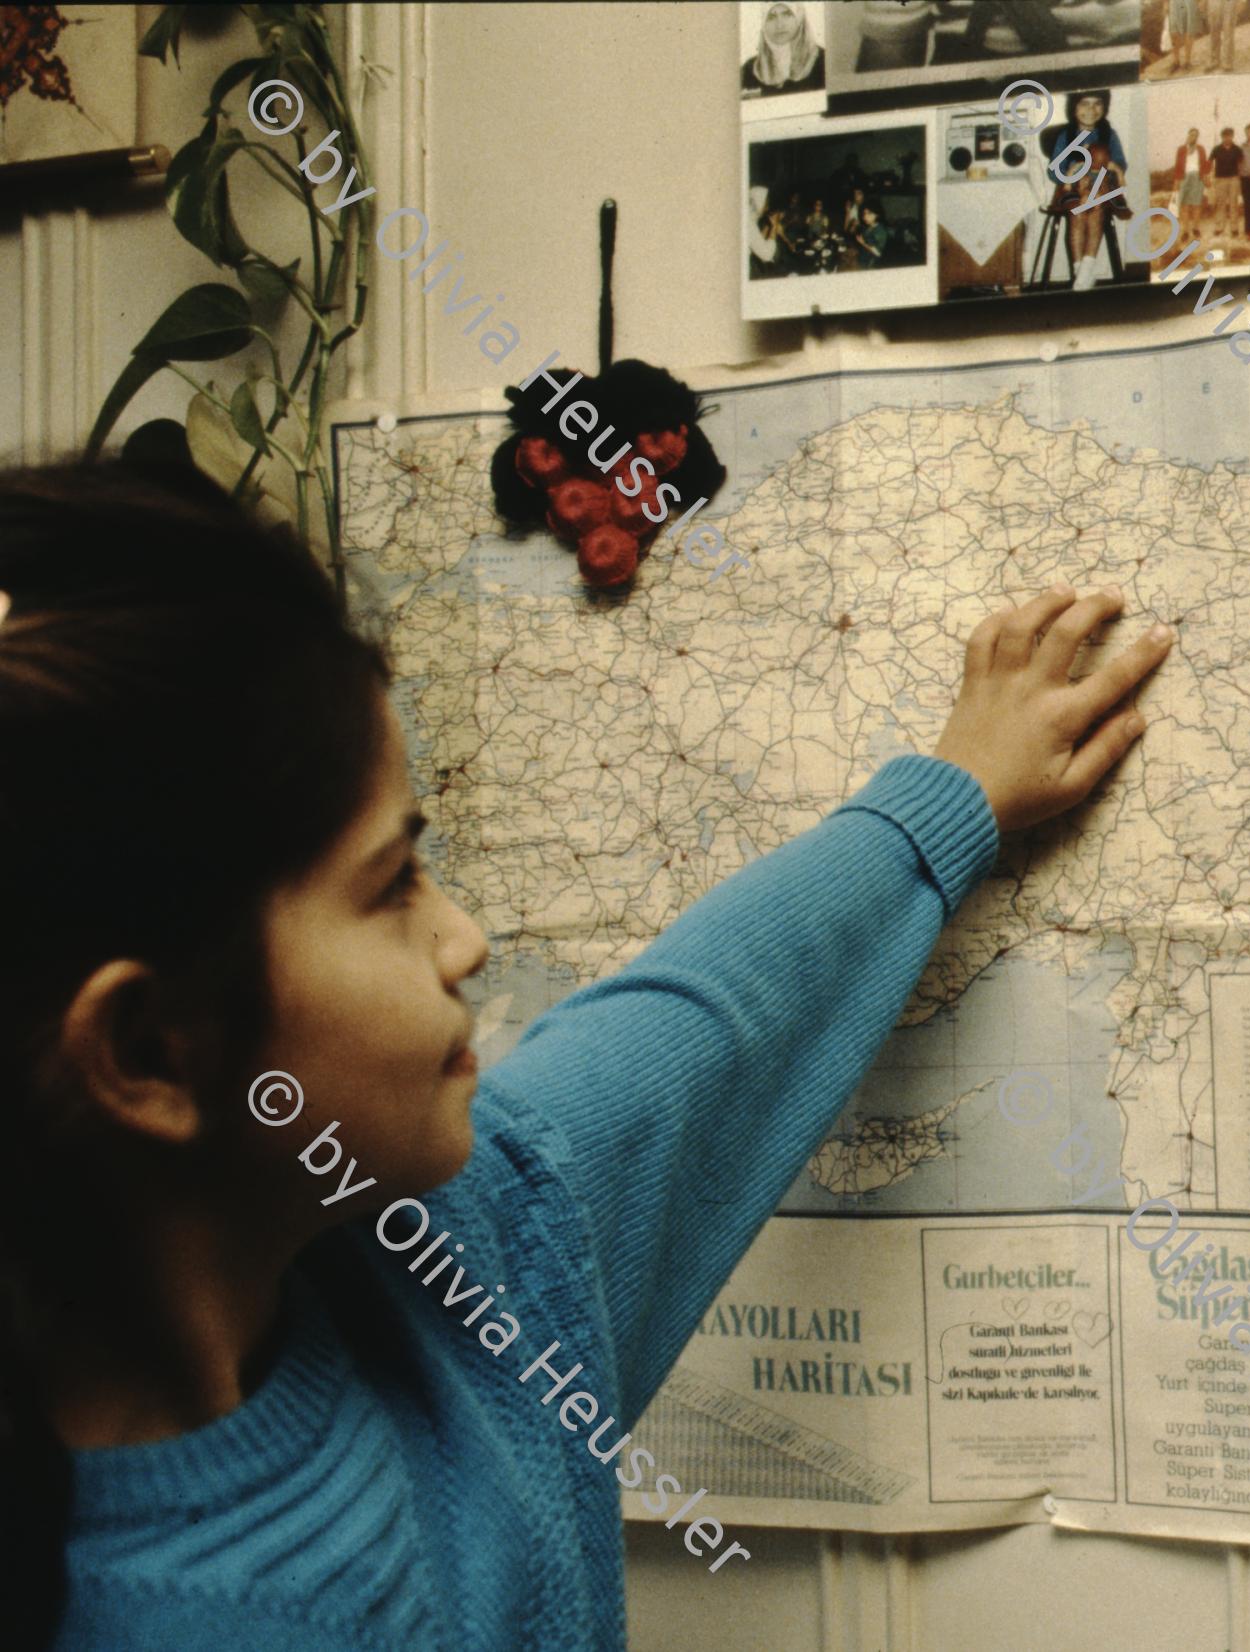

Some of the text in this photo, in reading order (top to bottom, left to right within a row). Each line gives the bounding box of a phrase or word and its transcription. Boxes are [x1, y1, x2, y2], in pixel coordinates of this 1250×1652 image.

[698, 1303, 861, 1344] AYOLLARI
[969, 1323, 1016, 1338] Garanti
[752, 1352, 914, 1397] HARİTASI
[1004, 1367, 1018, 1379] ve
[1155, 1375, 1189, 1391] Yurt
[1152, 1439, 1215, 1458] Garanti
